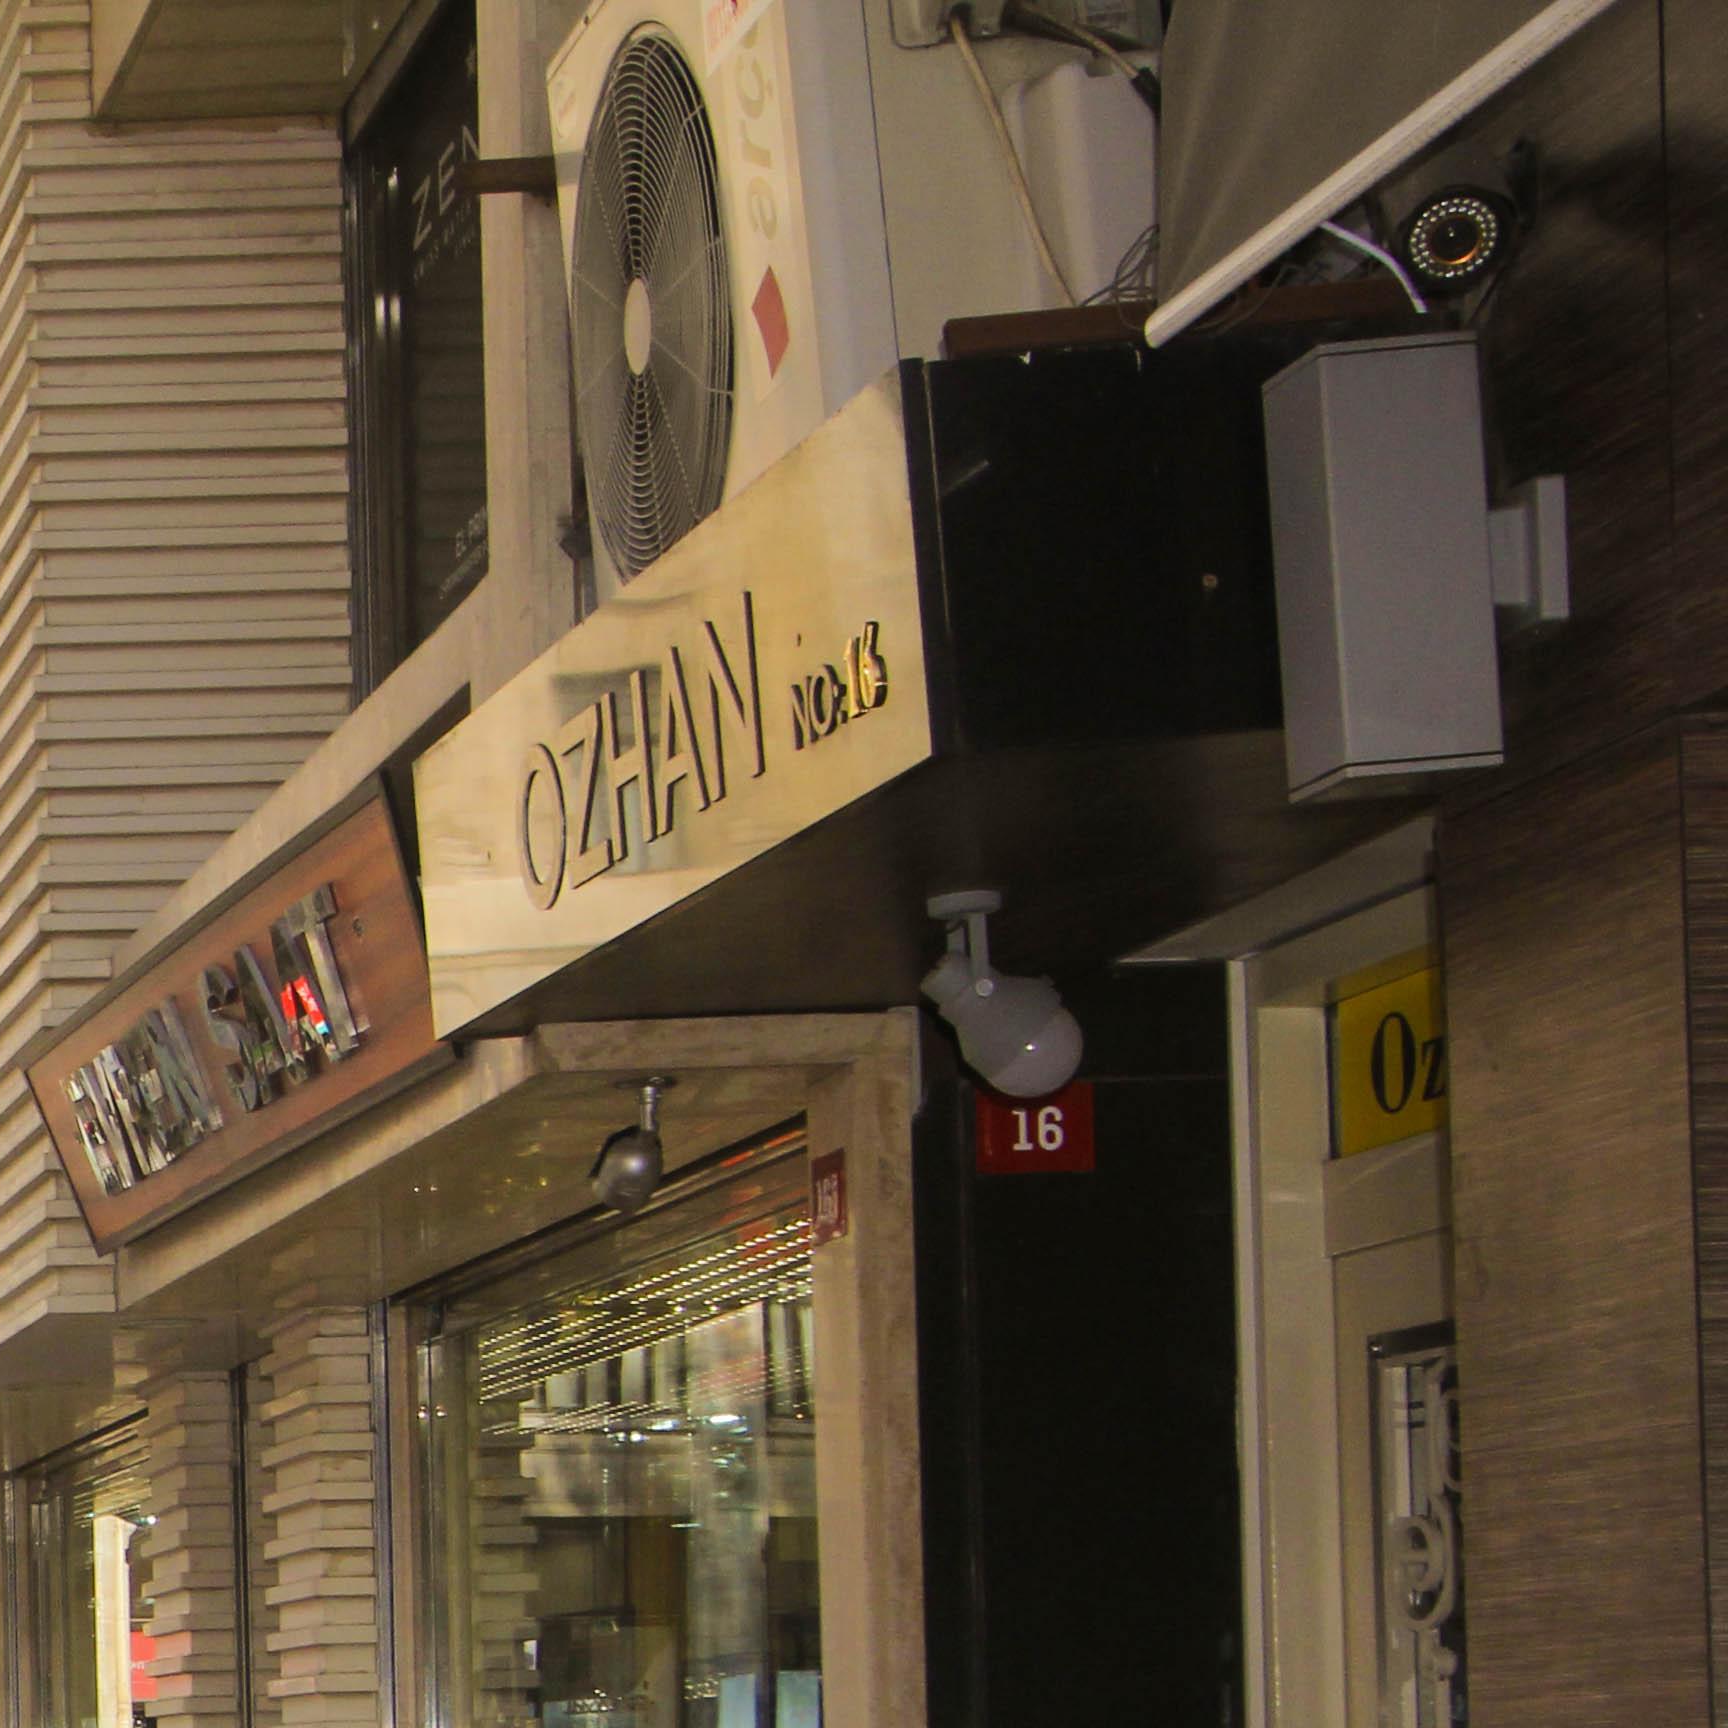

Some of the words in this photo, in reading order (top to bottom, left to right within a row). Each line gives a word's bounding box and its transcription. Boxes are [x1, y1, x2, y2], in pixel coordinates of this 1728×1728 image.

[516, 590, 766, 911] OZHAN
[198, 880, 371, 1113] SAAT
[1012, 1105, 1065, 1152] 16
